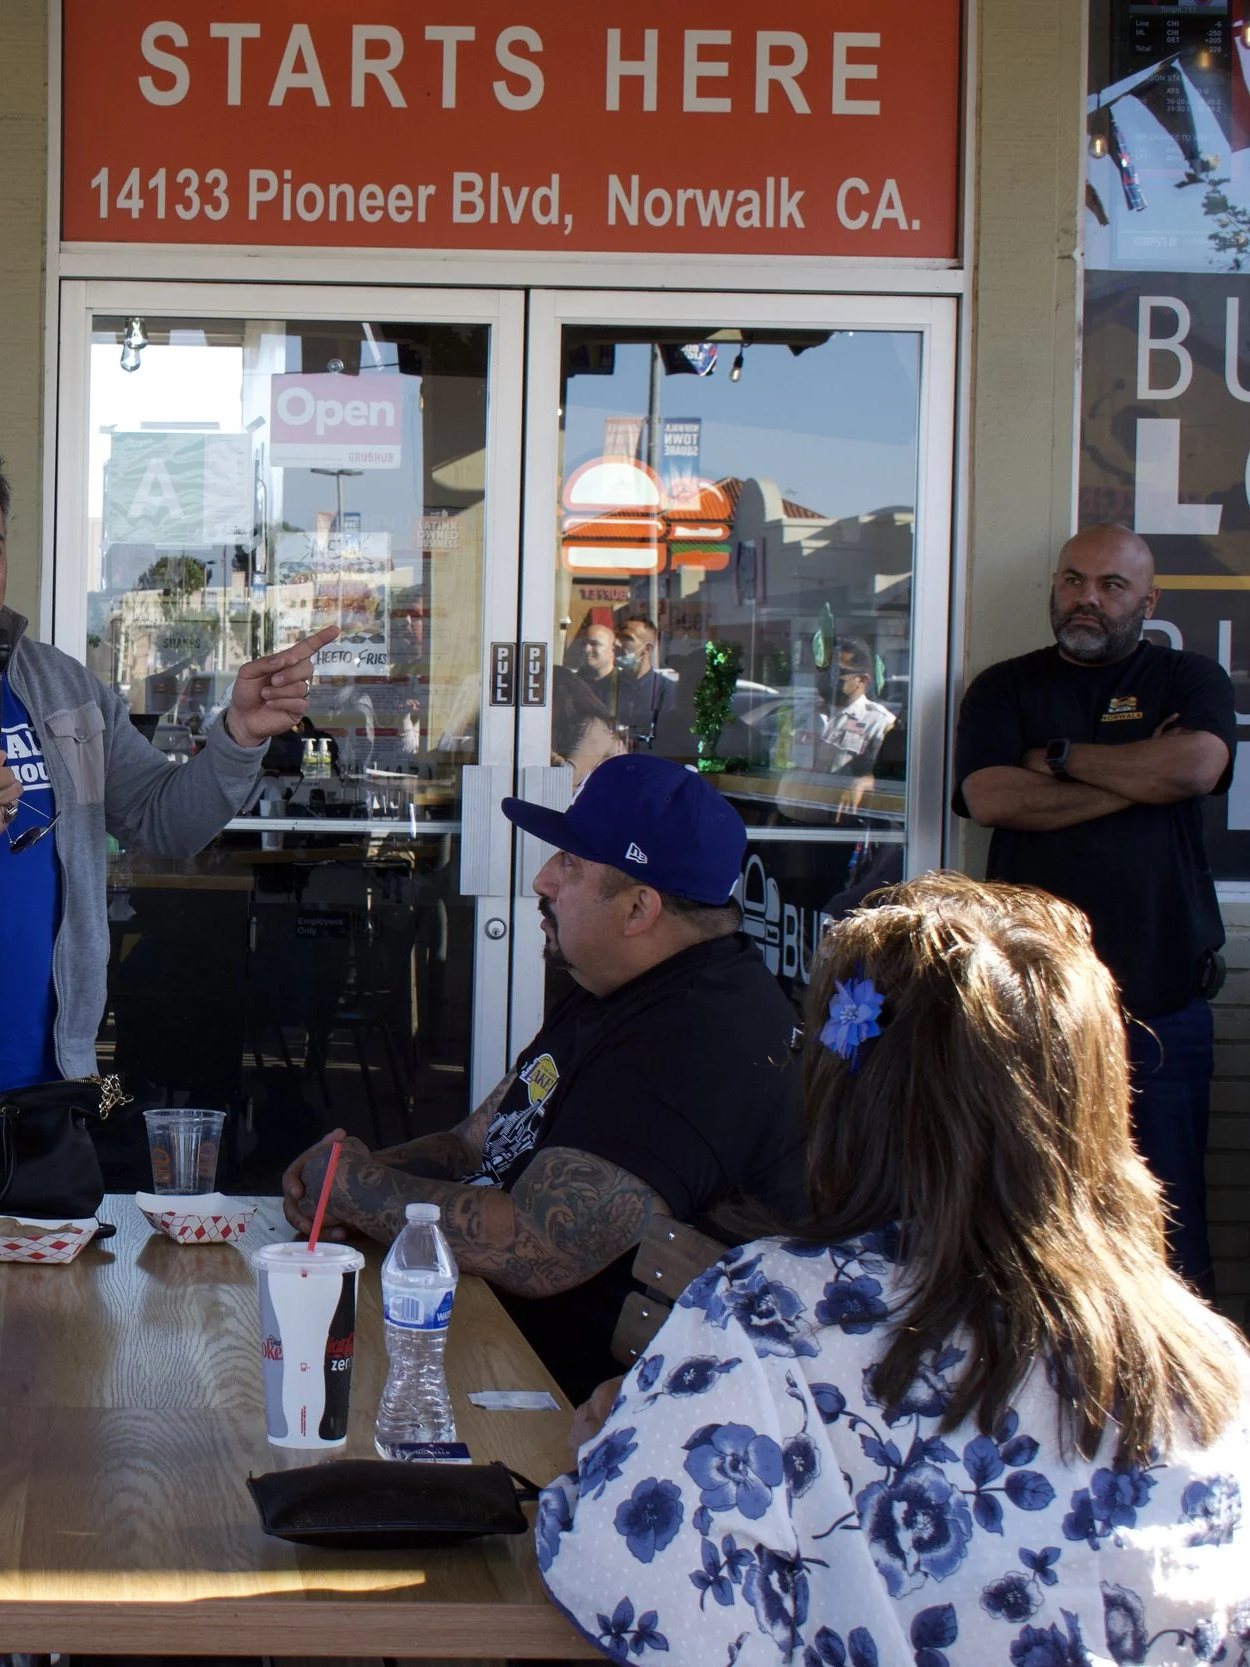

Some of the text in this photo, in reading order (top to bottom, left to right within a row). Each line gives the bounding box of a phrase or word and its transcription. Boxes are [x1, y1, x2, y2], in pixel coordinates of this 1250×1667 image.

[137, 20, 881, 116] STARTS HERE
[90, 167, 921, 236] 14133 Pioneer Blvd, Norwalk CA.
[276, 387, 395, 436] Open
[348, 452, 395, 463] GRUBHUB
[1134, 418, 1250, 535] L
[127, 457, 183, 519] A
[313, 648, 388, 669] HEETO FRIES
[496, 647, 509, 702] PULL
[528, 647, 541, 702] PULL
[297, 918, 344, 927] Employees
[297, 926, 317, 937] Only
[262, 1337, 284, 1361] oke
[331, 1356, 353, 1371] zer
